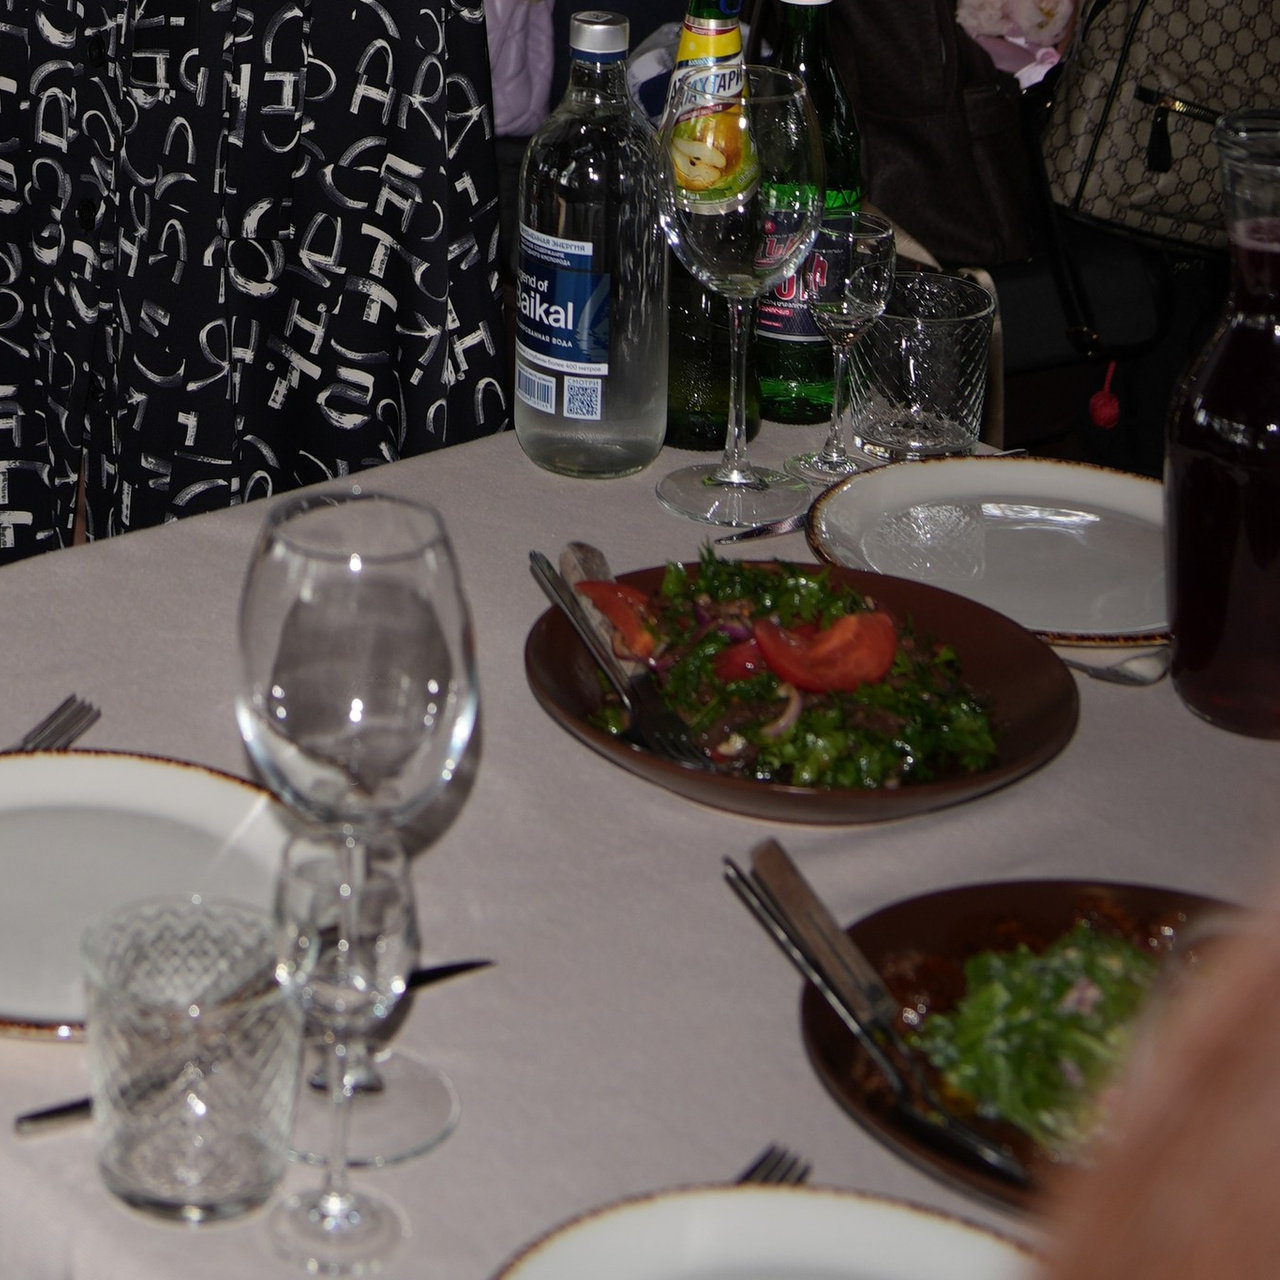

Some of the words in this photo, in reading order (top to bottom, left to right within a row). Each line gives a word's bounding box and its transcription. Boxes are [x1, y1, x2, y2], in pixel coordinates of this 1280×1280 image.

[552, 240, 585, 252] ЭНЕРГИЯ
[517, 268, 536, 288] egend
[537, 279, 549, 292] of
[552, 336, 573, 348] ВОДА
[567, 378, 599, 387] СМОТРИ
